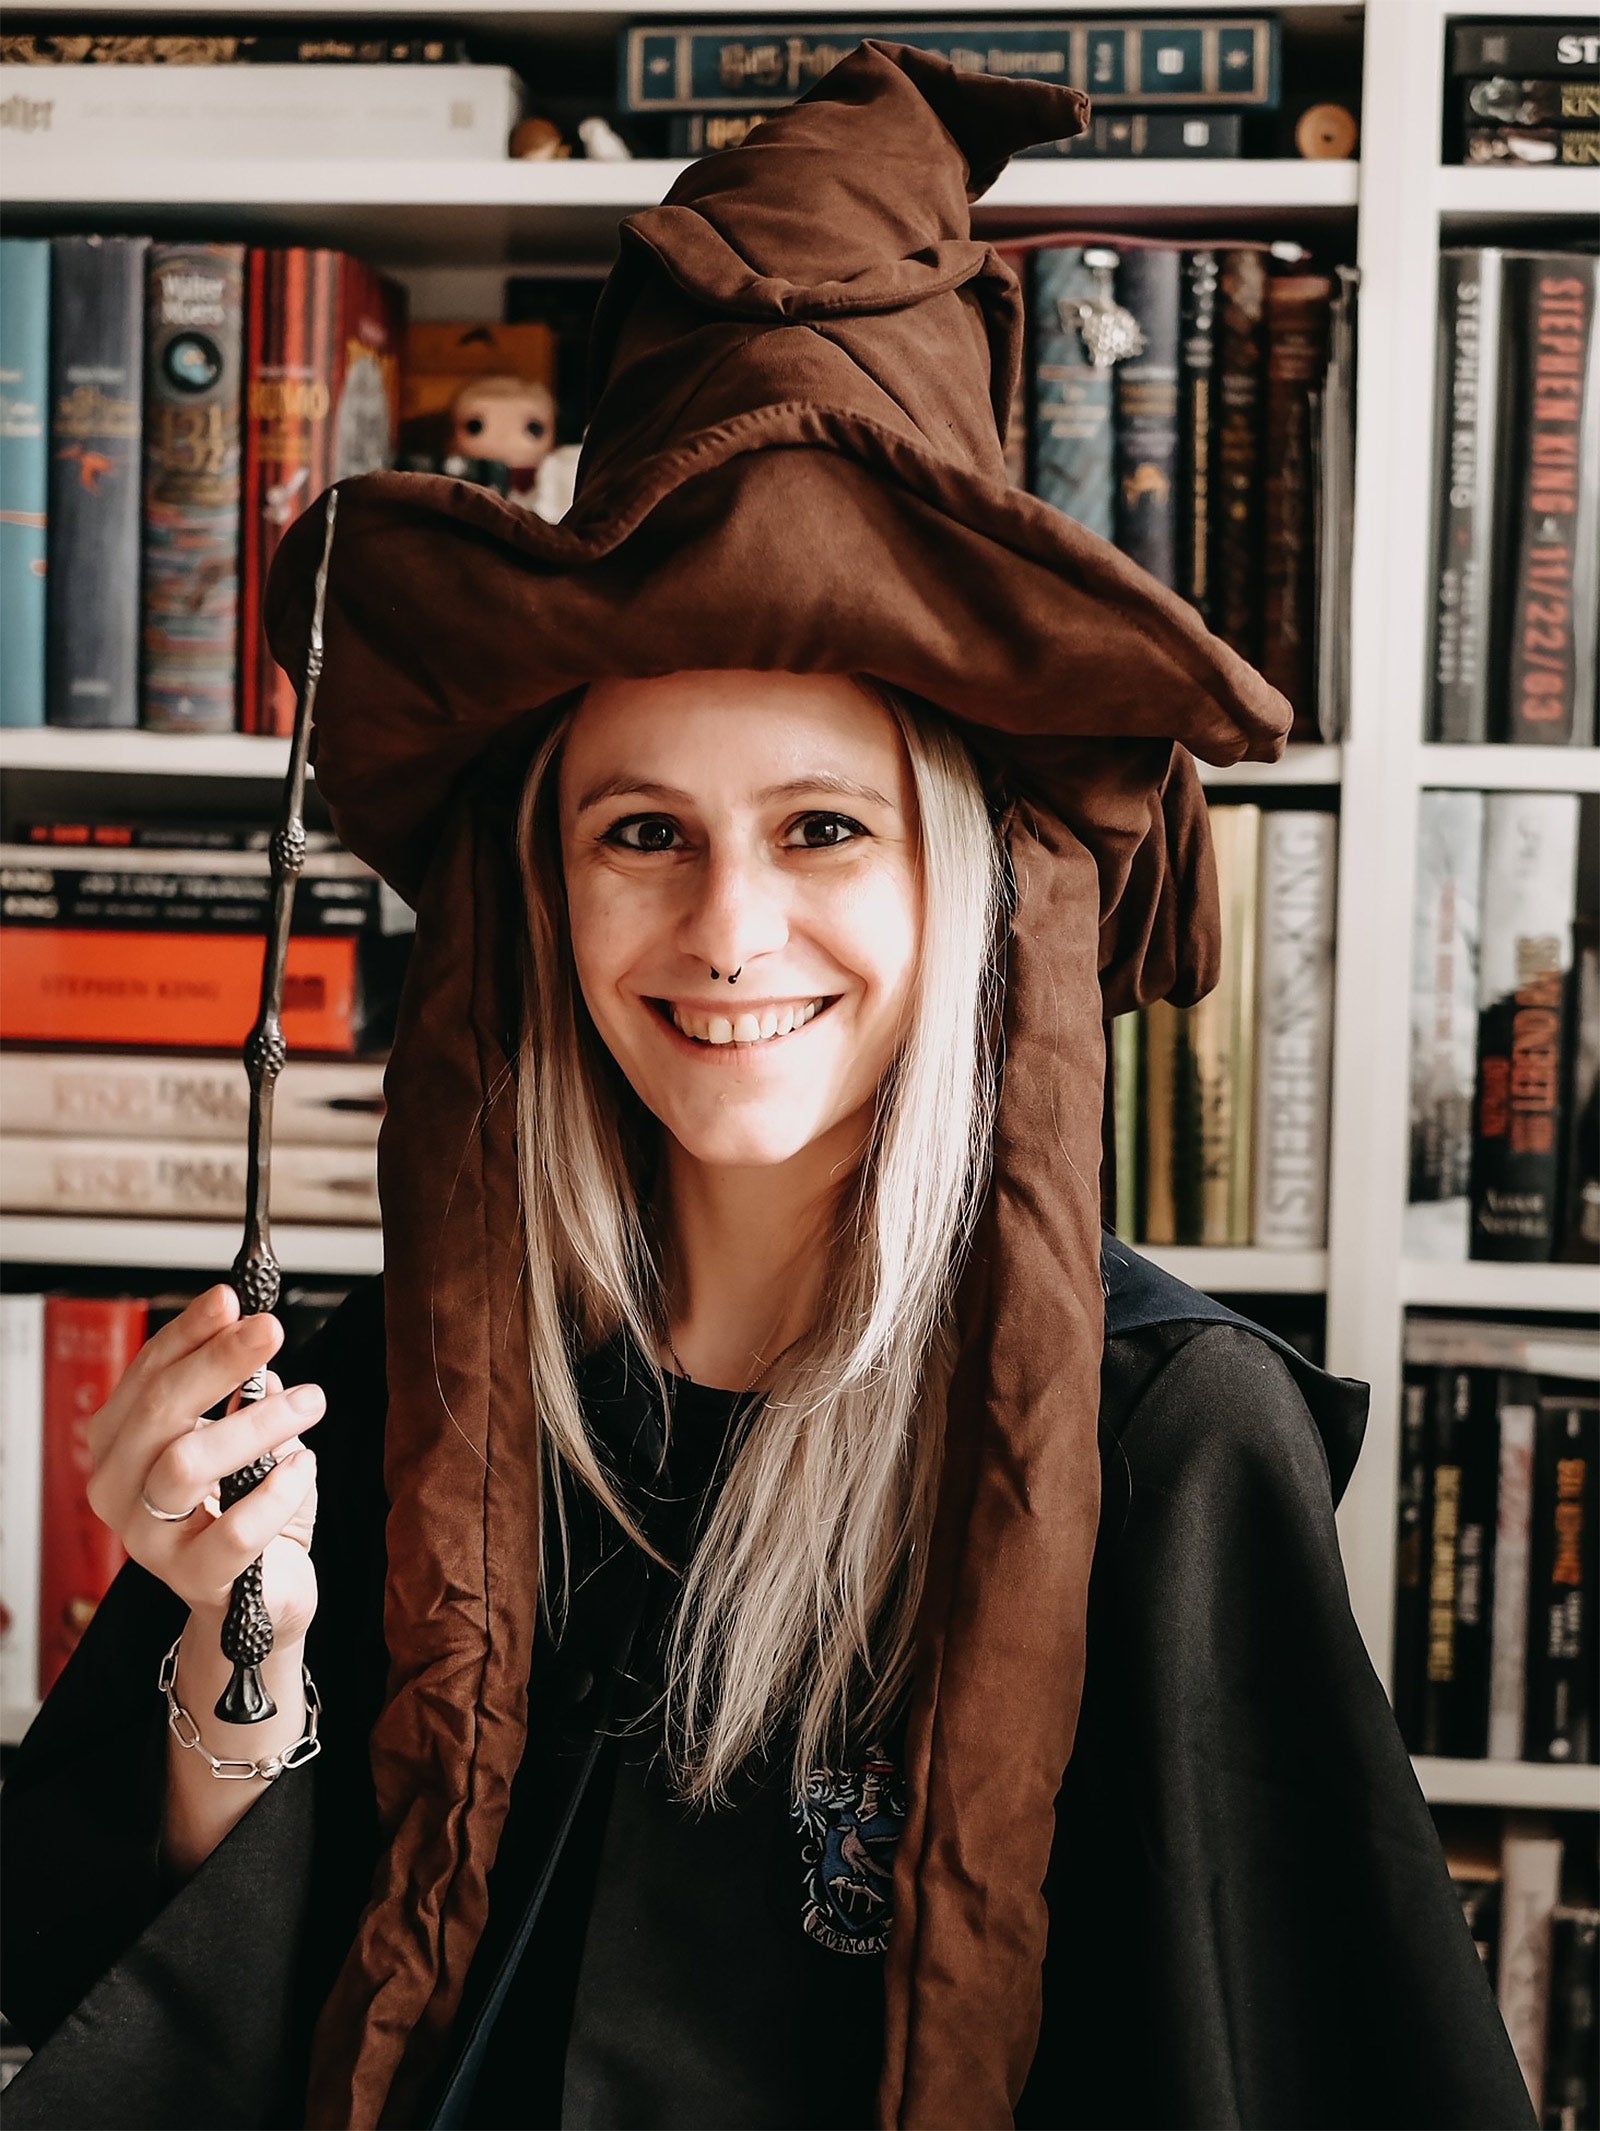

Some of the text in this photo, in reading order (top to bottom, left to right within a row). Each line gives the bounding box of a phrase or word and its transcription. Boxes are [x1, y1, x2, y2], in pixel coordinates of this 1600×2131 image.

[1450, 281, 1478, 509] STEPHEN KING
[1522, 278, 1584, 722] STEPHEN KING 11/22/63
